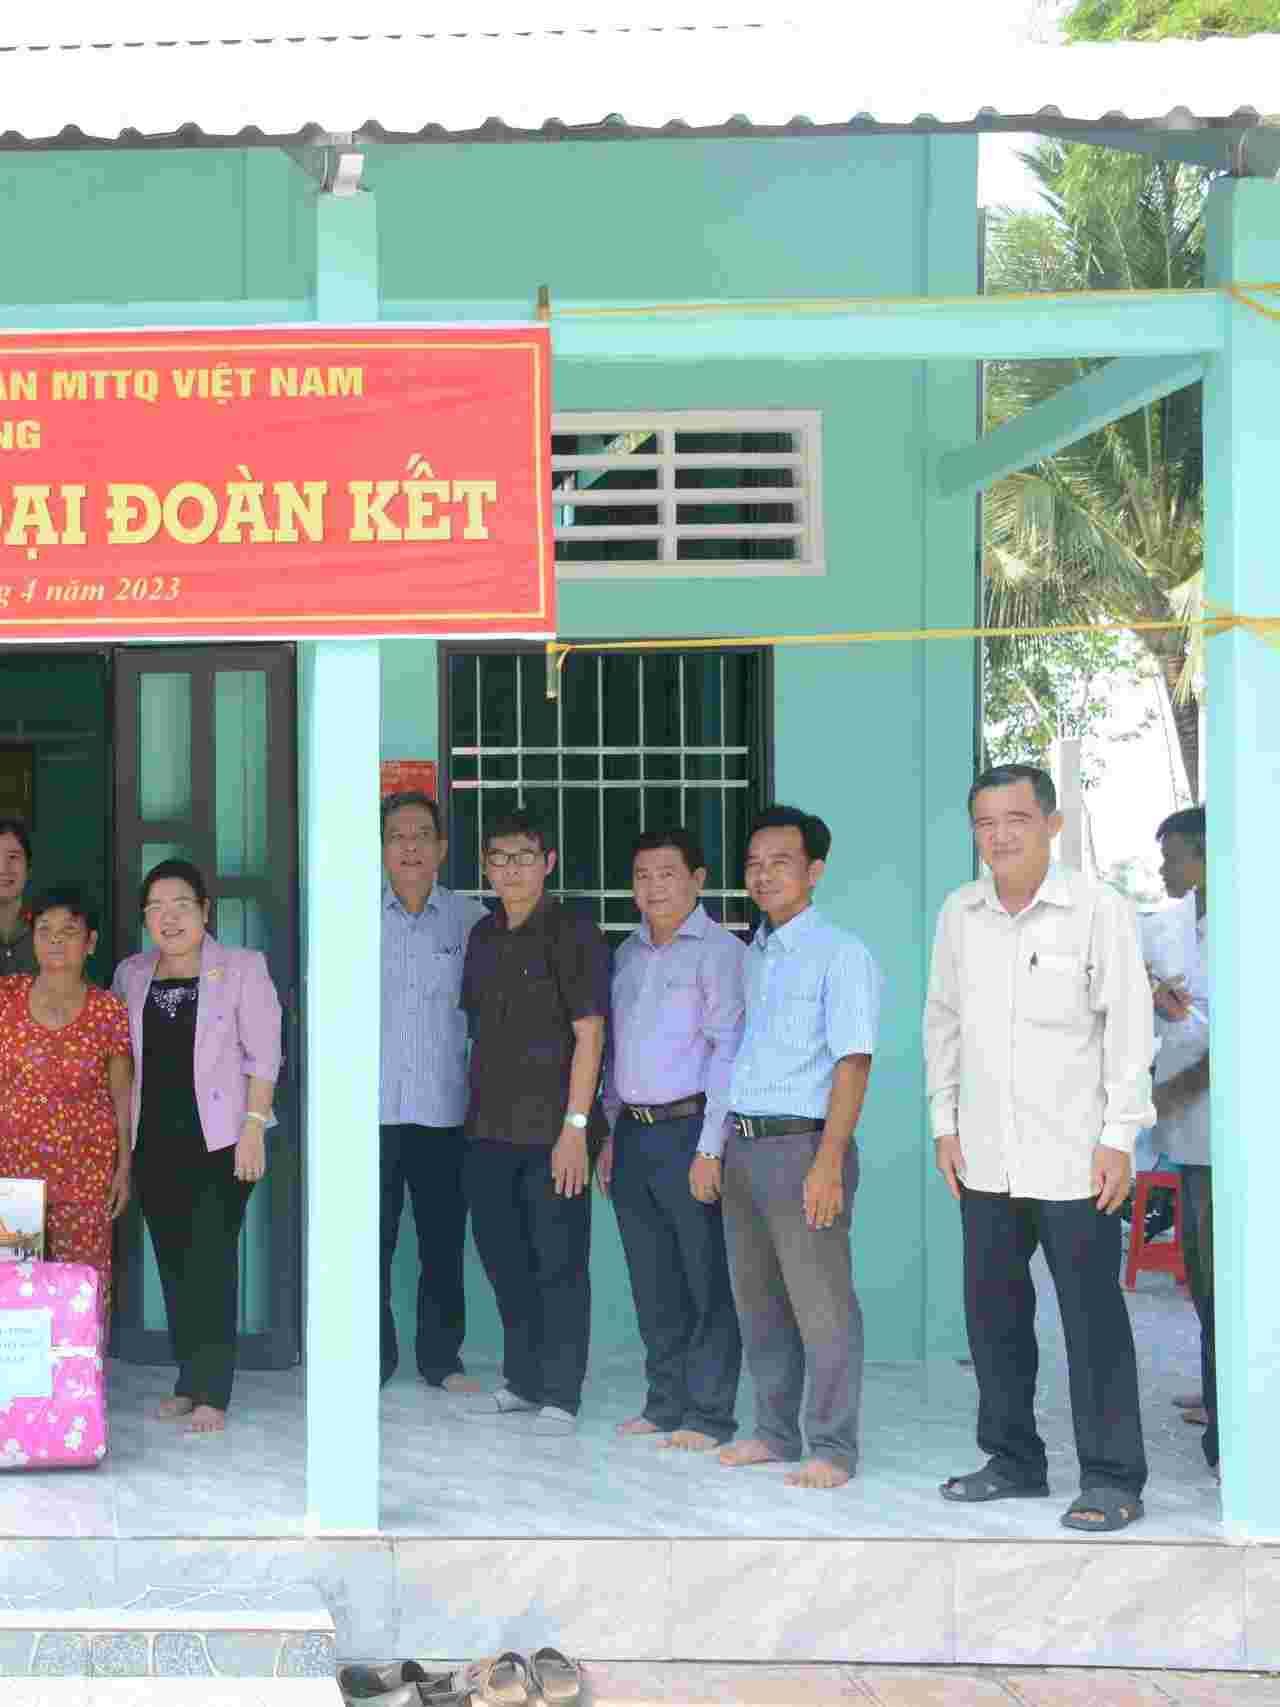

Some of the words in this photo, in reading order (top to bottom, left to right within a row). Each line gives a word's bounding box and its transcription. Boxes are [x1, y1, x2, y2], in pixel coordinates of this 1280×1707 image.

[51, 368, 159, 401] MTTQ
[172, 363, 256, 404] VIỆT
[269, 366, 363, 398] NAM
[105, 464, 327, 544] ĐOÀN
[348, 452, 497, 541] KẾT
[46, 579, 104, 601] năm
[113, 576, 182, 601] 2023
